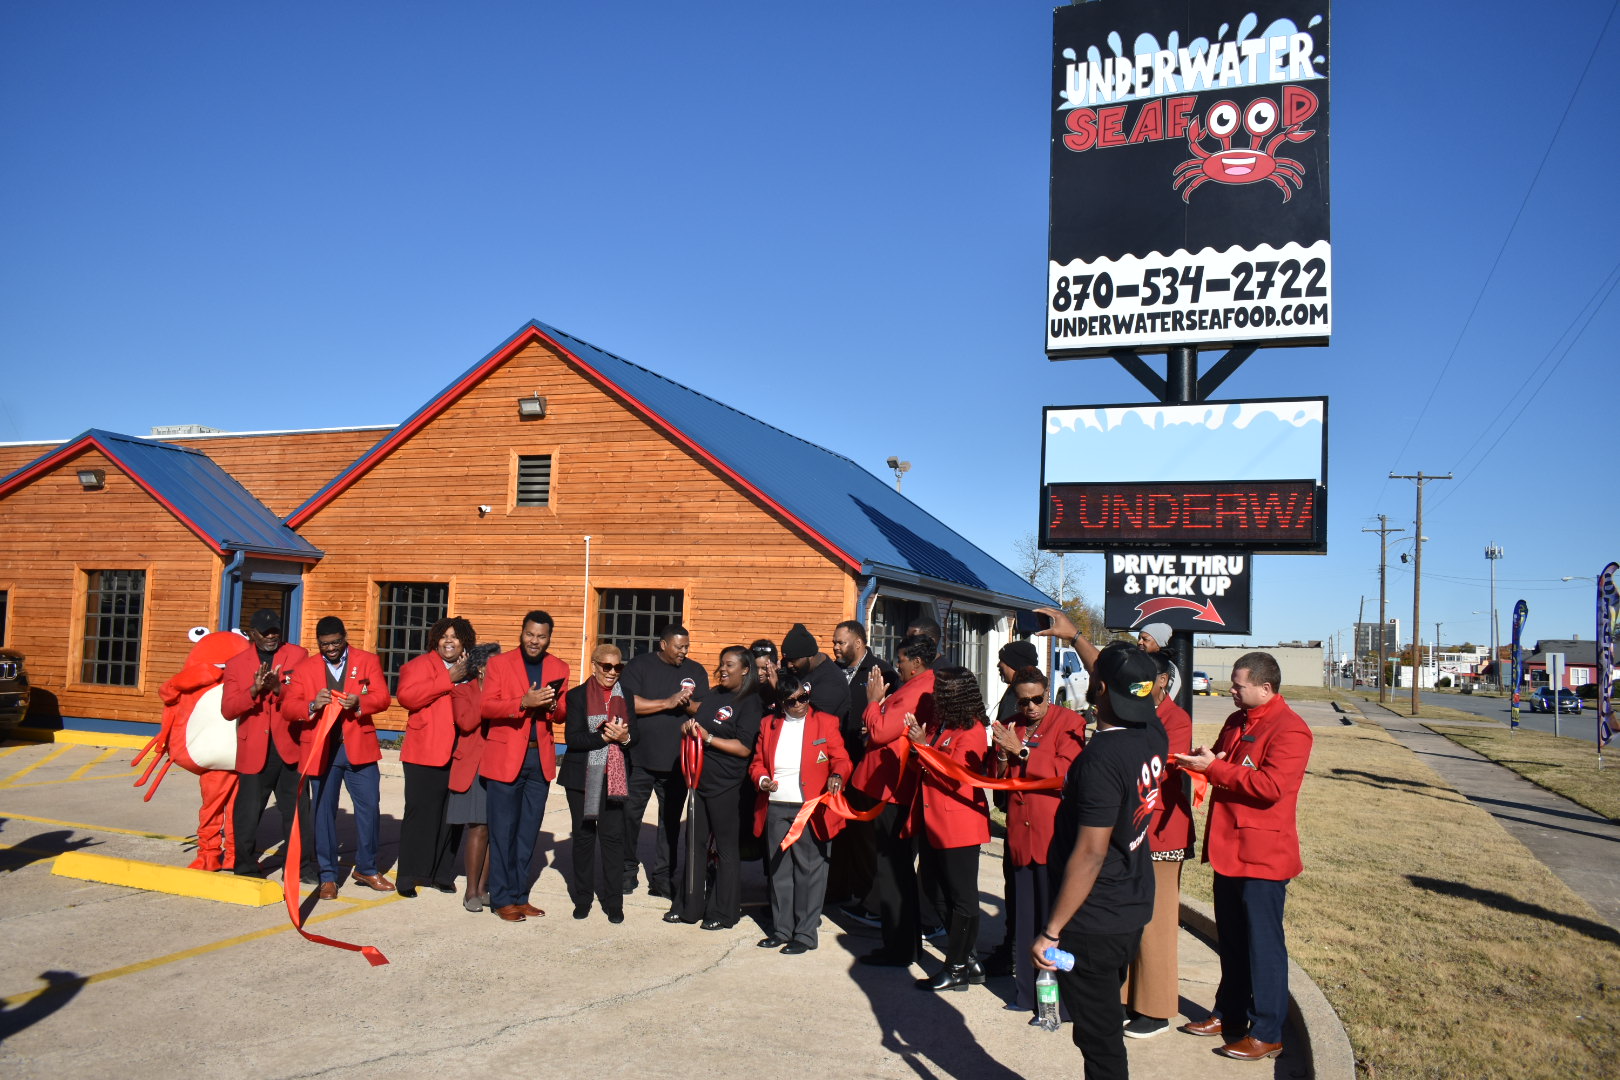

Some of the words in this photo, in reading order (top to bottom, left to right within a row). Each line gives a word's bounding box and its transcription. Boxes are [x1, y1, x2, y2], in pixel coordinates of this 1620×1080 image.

[1065, 31, 1315, 106] UNDERWATER
[1052, 257, 1327, 312] 870-534-2722
[1050, 303, 1329, 338] UNDERWATERSEAFOOD.COM
[1112, 554, 1175, 574] DRIVE
[1181, 555, 1244, 576] THRU
[1124, 575, 1141, 594] &
[1145, 575, 1195, 596] PICK
[1200, 576, 1232, 596] UP
